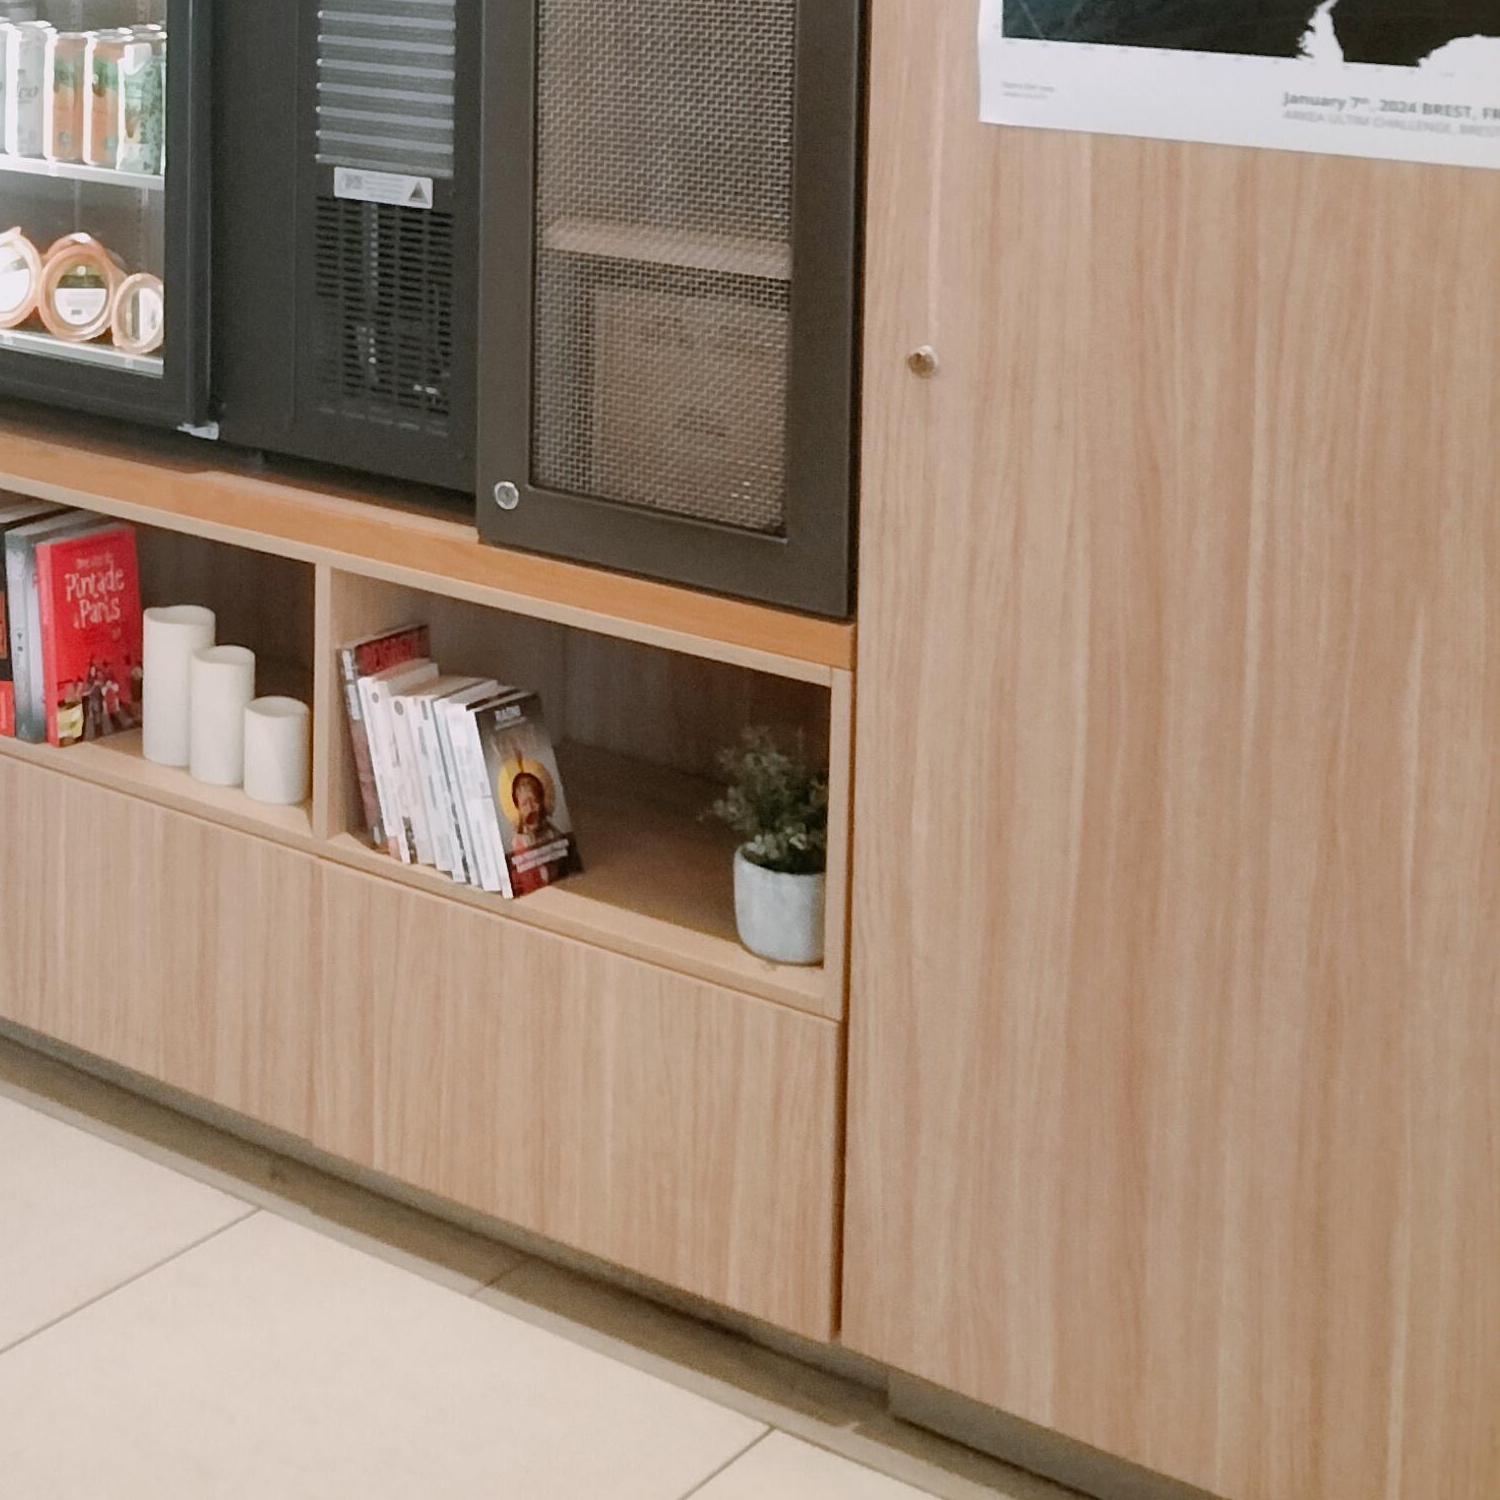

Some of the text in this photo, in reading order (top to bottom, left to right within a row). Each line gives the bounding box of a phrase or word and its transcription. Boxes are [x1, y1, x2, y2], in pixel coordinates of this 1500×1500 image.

[1283, 91, 1348, 111] January
[1379, 98, 1418, 114] 2024
[79, 596, 121, 628] Paris
